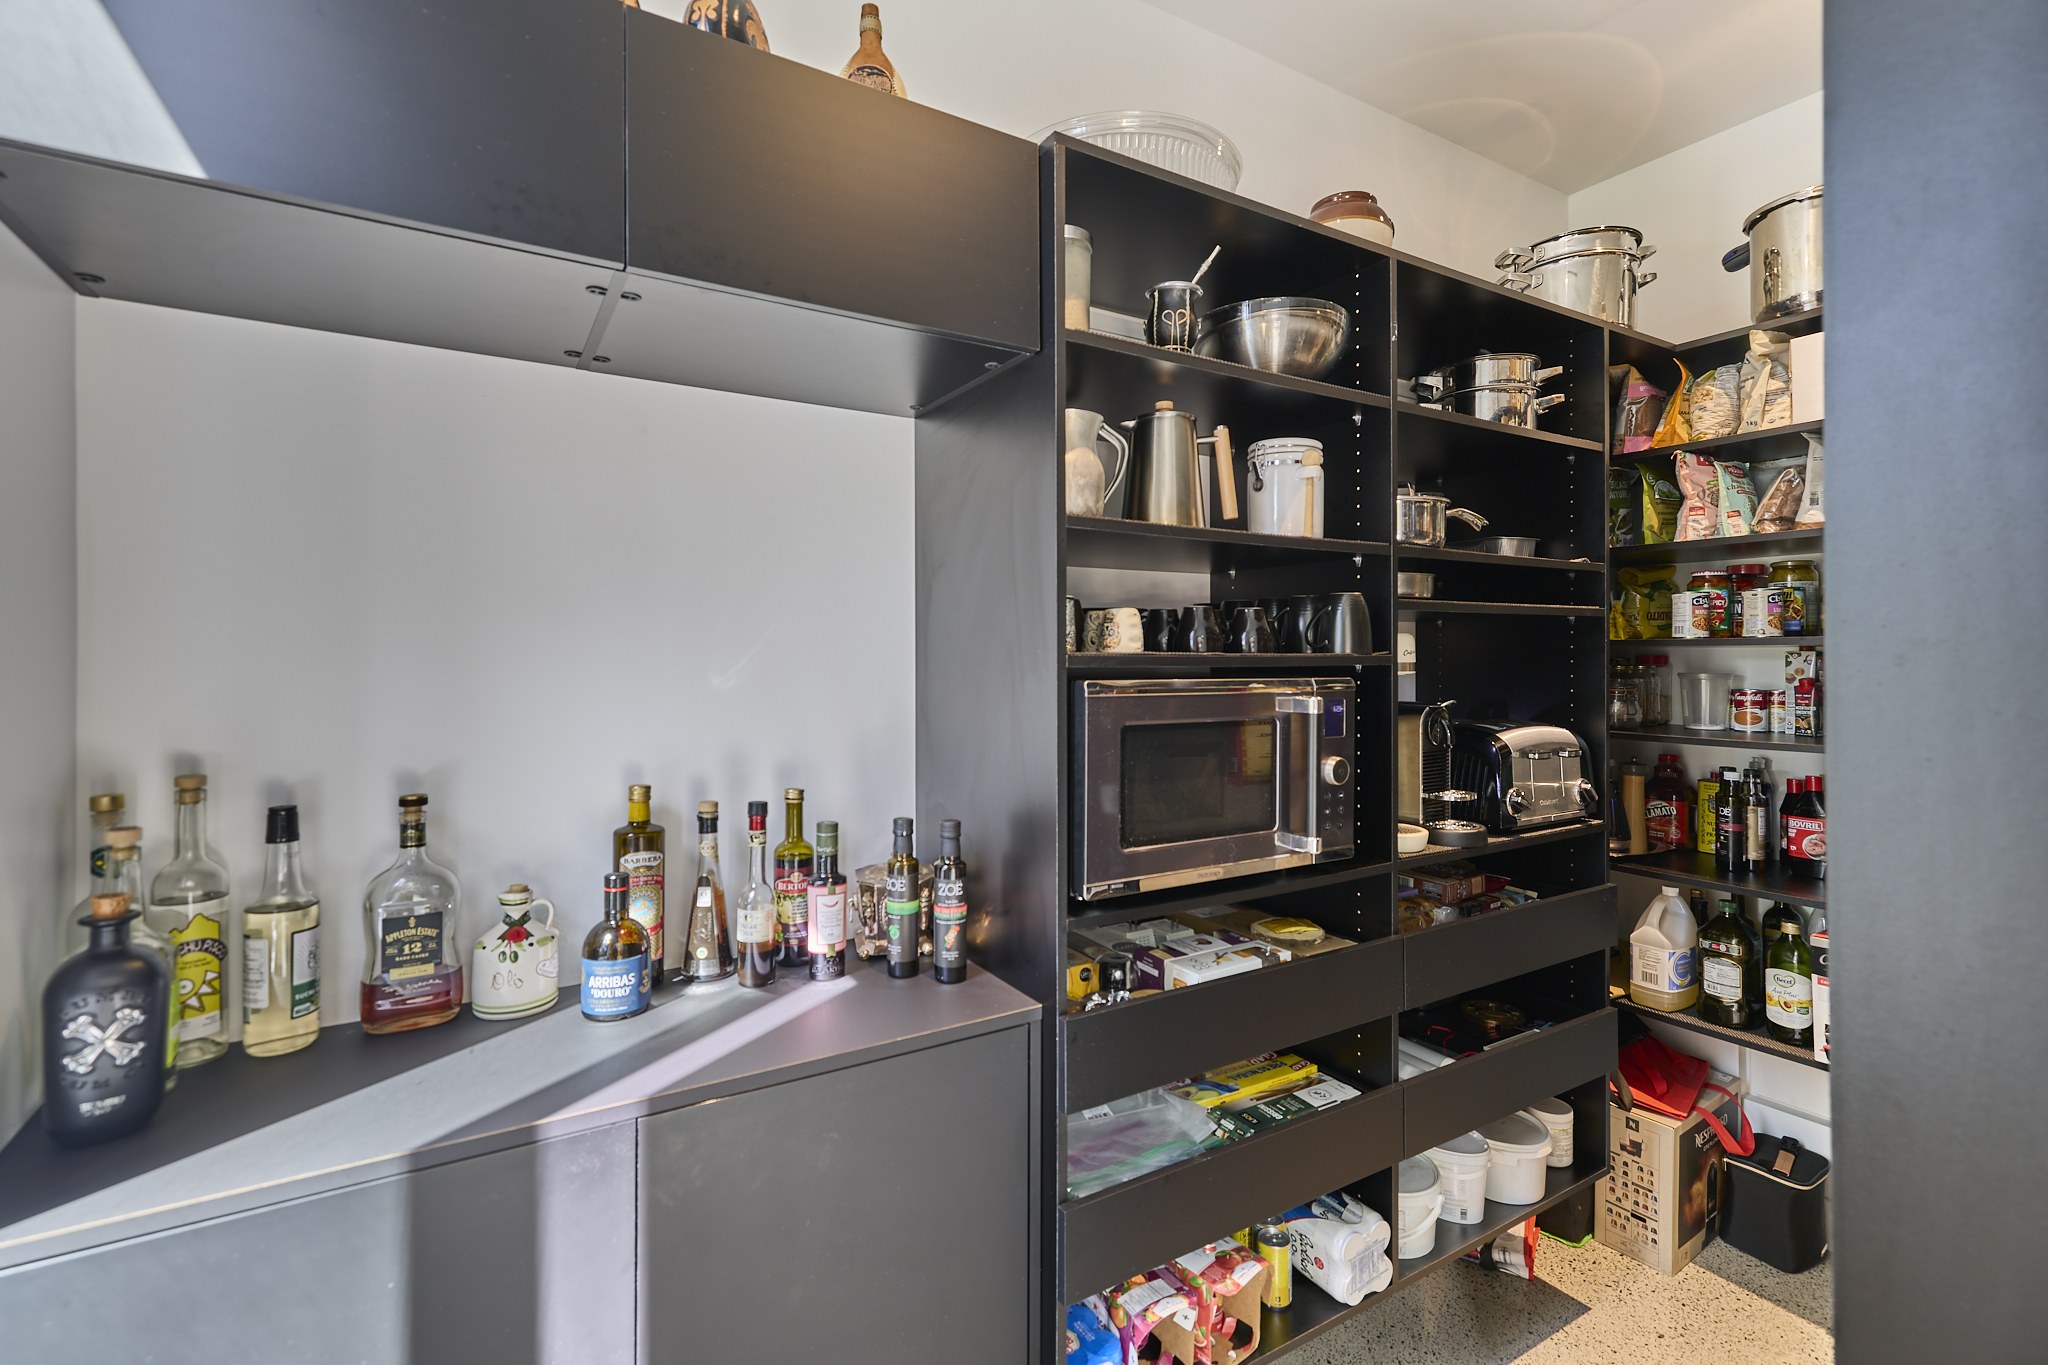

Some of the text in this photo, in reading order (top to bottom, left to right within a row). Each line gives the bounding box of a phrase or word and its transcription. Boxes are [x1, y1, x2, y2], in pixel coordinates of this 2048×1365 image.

[1789, 820, 1820, 830] BOVRIL
[623, 855, 662, 865] BARBERA
[886, 876, 906, 892] ZOË
[938, 880, 964, 896] ZOË
[385, 926, 439, 944] APPLETON ESTATE
[402, 941, 422, 955] 12
[588, 972, 636, 988] ARRIBAS
[1775, 975, 1793, 985] Becel
[1291, 1060, 1310, 1071] GLAD
